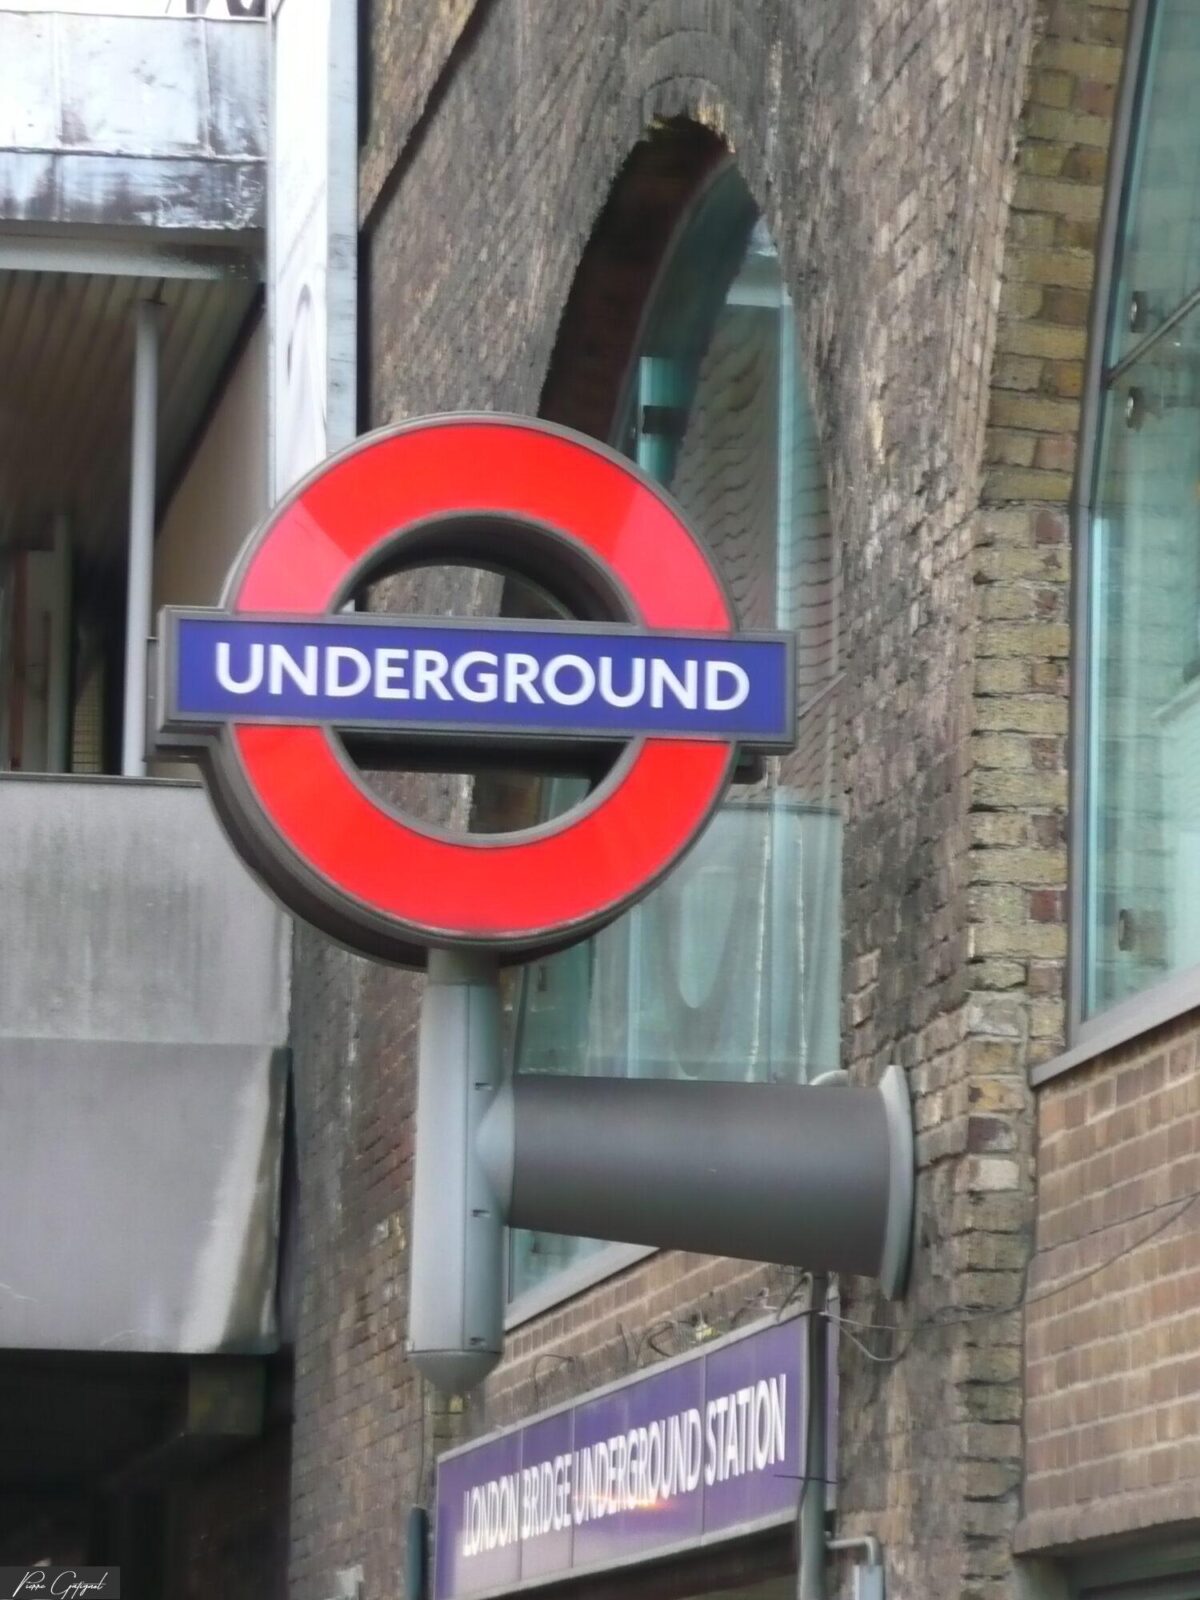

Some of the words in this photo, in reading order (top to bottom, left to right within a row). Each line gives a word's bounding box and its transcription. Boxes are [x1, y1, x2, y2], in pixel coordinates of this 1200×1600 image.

[215, 641, 750, 710] UNDERGROUND
[463, 1472, 520, 1556] LONDON
[521, 1452, 573, 1539] BRIDGE
[573, 1408, 703, 1525] UNDERGROUND
[704, 1373, 787, 1486] STATION
